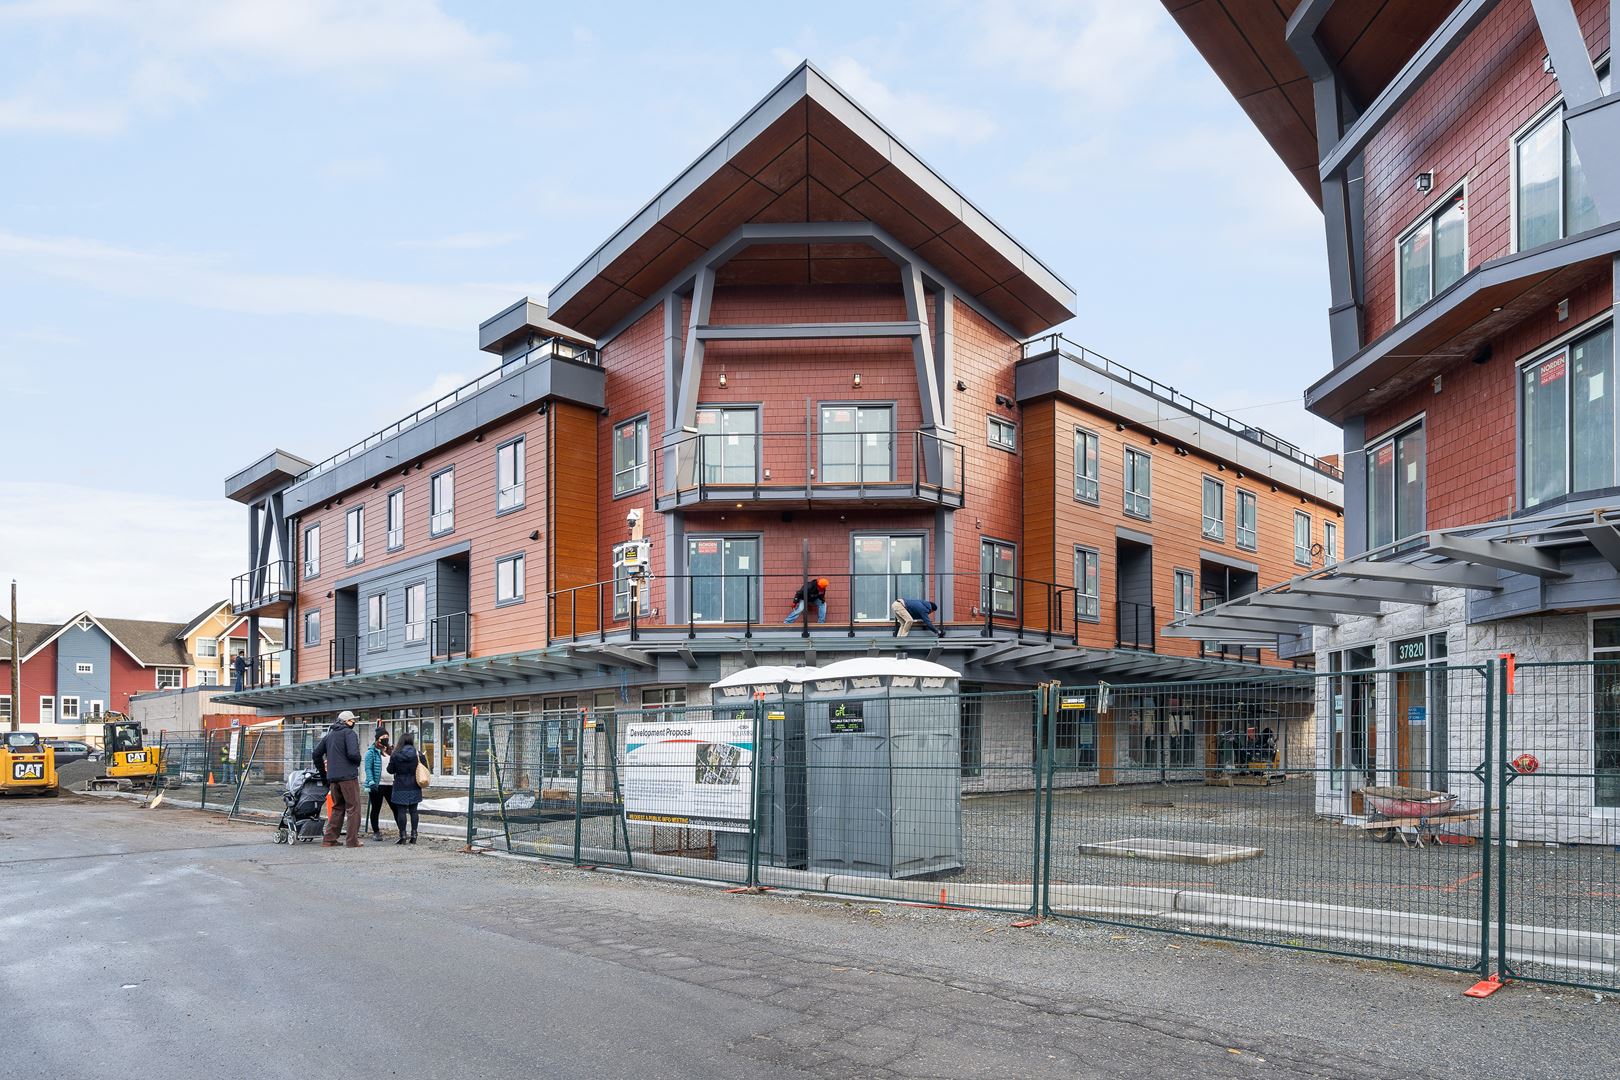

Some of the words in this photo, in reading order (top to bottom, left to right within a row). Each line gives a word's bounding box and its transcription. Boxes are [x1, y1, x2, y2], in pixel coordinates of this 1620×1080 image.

[1540, 356, 1565, 374] NORDEN
[1399, 642, 1424, 659] 37820
[630, 728, 665, 738] Development
[665, 727, 693, 738] Proposal
[127, 752, 146, 763] CAT
[15, 764, 43, 778] CAT
